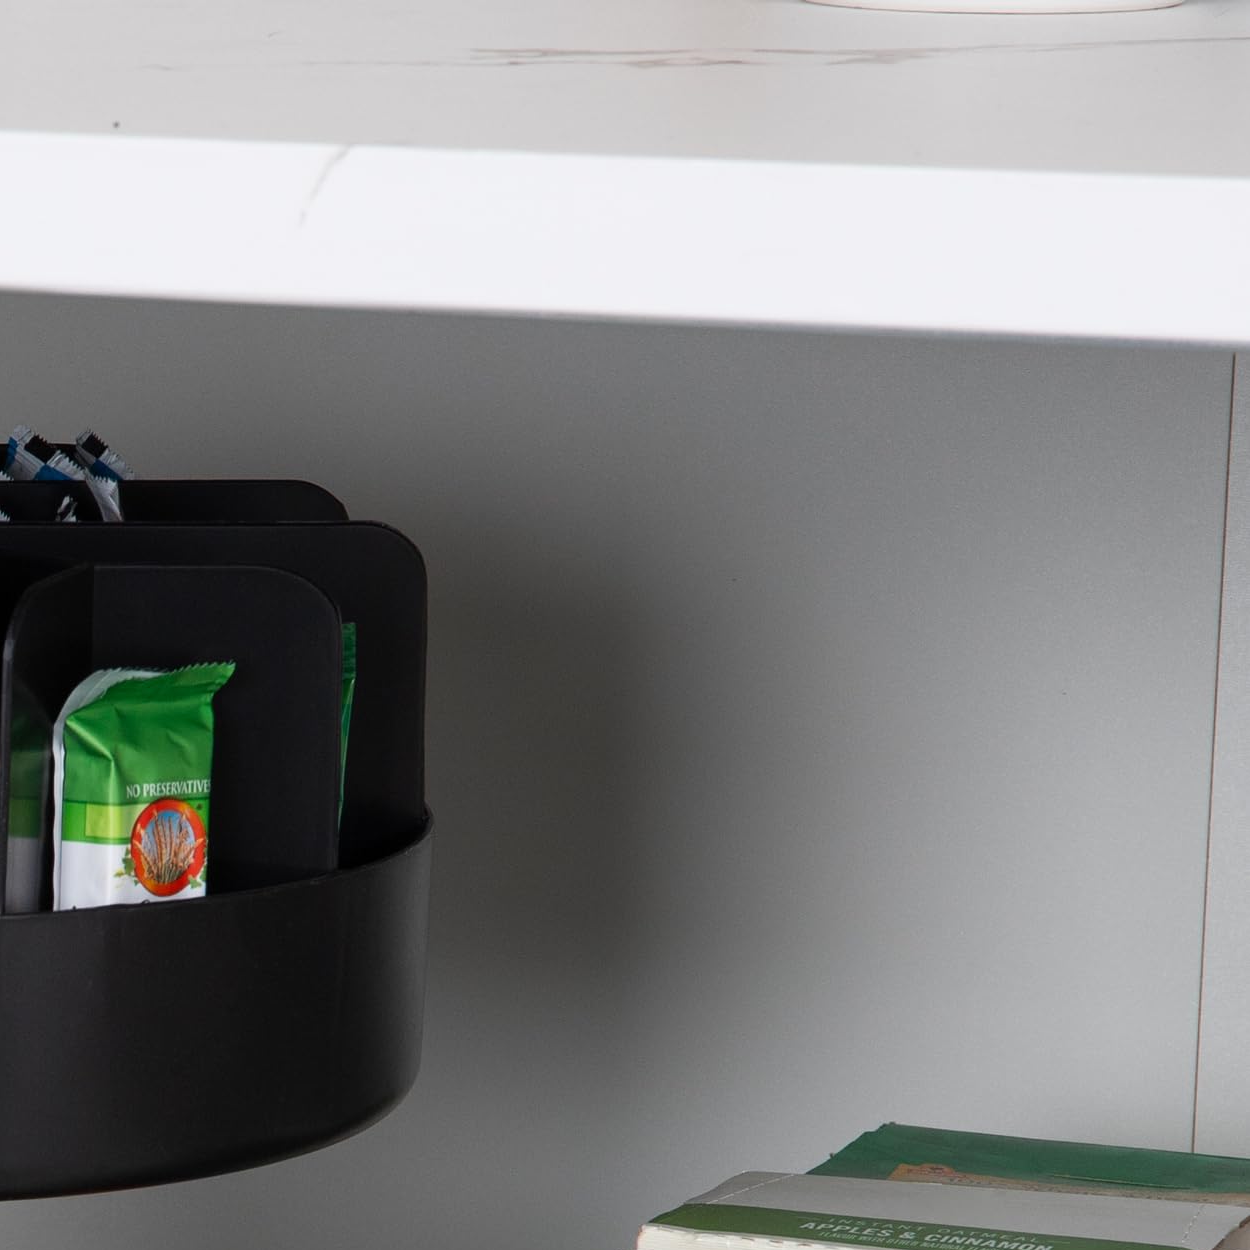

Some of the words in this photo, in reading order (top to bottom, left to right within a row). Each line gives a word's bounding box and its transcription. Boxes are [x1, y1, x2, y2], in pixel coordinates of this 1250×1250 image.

[126, 784, 140, 798] NO
[800, 1222, 894, 1238] APPLES
[899, 1231, 918, 1240] &
[828, 1217, 926, 1231] INSTANT
[937, 1228, 1038, 1242] OATMEAL
